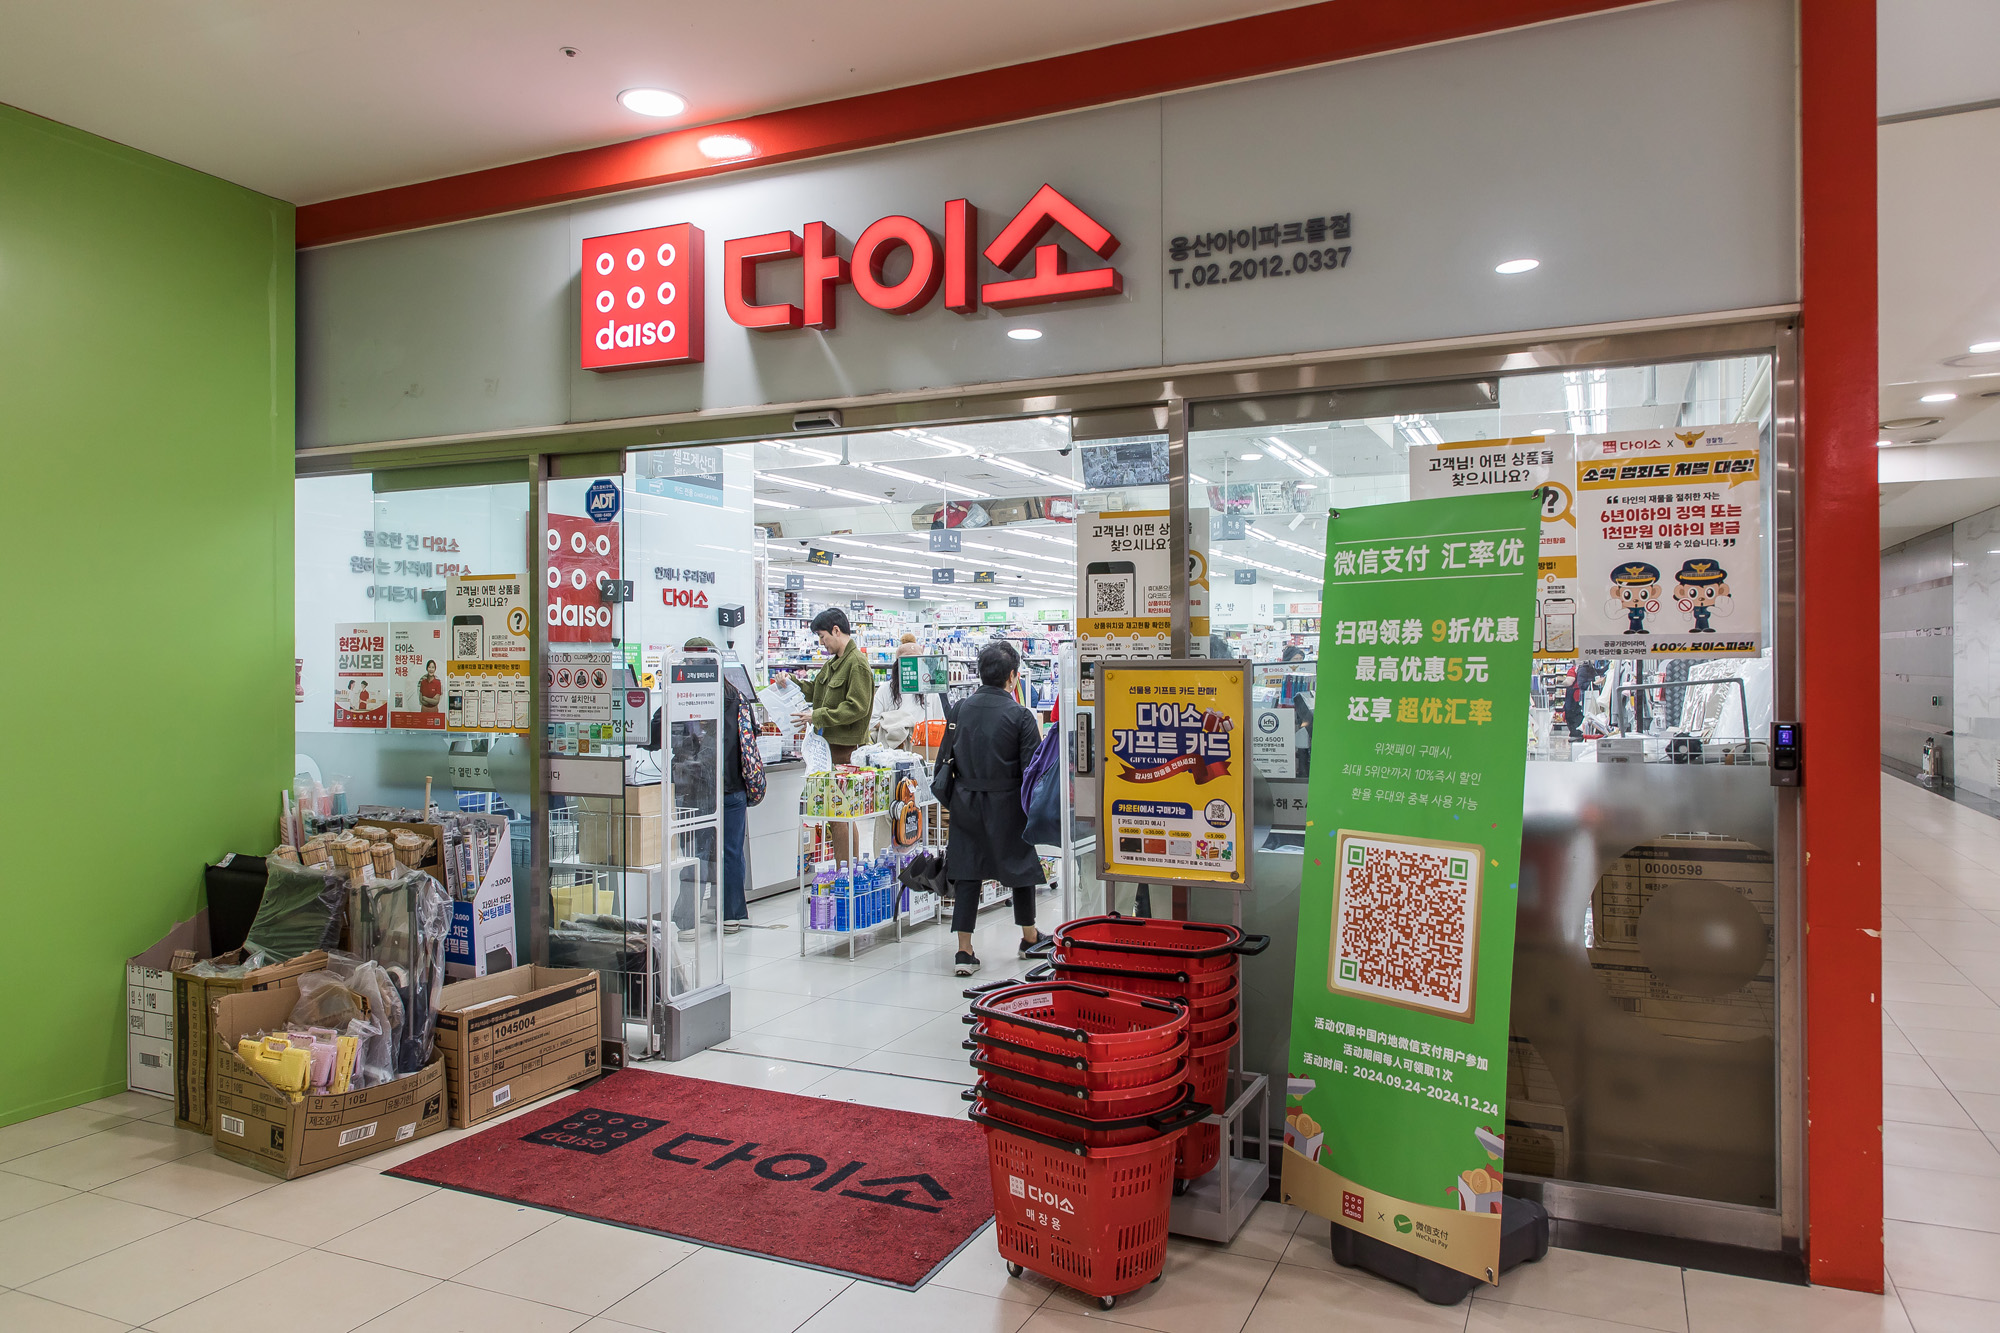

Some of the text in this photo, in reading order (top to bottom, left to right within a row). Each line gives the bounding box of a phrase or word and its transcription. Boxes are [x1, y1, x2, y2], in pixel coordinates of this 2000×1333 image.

[1169, 213, 1353, 261] 용산아이파크몰점
[724, 184, 1123, 333] 다이소
[1169, 247, 1352, 291] T.02.2012.0337
[595, 319, 676, 350] daiso
[1620, 440, 1661, 451] 다이소
[1429, 450, 1554, 473] 고객님! 어떤 상품을
[1582, 458, 1755, 483] 소액 범죄도 처벌 대상!
[1452, 469, 1530, 487] 찾으시나요?
[591, 493, 615, 510] ADT
[1649, 494, 1673, 503] 재물을
[1676, 492, 1701, 502] 절취한
[1703, 491, 1720, 500] 자는
[1600, 503, 1742, 523] 6년이하의 징역 또는
[1092, 524, 1129, 538] 고객님!
[1133, 523, 1156, 536] 어떤
[1602, 521, 1740, 540] 1천만원 이하의 벌금
[364, 530, 461, 552] 필요한 건 다있소
[1618, 537, 1721, 550] 으로 처벌 받을 수 있습니다.
[350, 556, 391, 574] 원하는
[1334, 538, 1525, 576] 微信支付 汇率优
[655, 567, 680, 580] 언제나
[456, 585, 520, 597] 고객님! 어떤 상품을
[607, 584, 629, 596] 2 2
[663, 588, 709, 609] 다이소
[468, 597, 508, 608] 찾으시나요?
[548, 598, 611, 627] daiso
[723, 612, 742, 622] 3 3
[1094, 621, 1150, 629] 상품위치와 재고현황
[1335, 616, 1519, 645] 扫码领券 9折优惠
[339, 636, 384, 652] 현장사원
[395, 644, 415, 653] 다이소
[1623, 647, 1647, 655] 요구하면
[1651, 640, 1754, 652] 100% 보이스피싱!
[339, 654, 384, 670] 상시모집
[395, 654, 423, 665] 현장 직원
[395, 666, 409, 677] 채용
[1355, 656, 1489, 683] 最高优惠5元
[550, 695, 596, 704] CCTV 설치안내
[1129, 686, 1217, 696] 선물용 기프트 카드 판매!
[1137, 703, 1203, 729] 다이소
[1347, 696, 1493, 725] 还享 超优汇率
[1113, 730, 1179, 755] 기프트
[1185, 731, 1230, 757] 카드
[1375, 742, 1452, 760] 위챗페이 구매시,
[1130, 756, 1147, 764] GIFT
[1341, 763, 1482, 786] 최대 5위안까지 10%즉시 할인
[1351, 787, 1478, 811] 환율 우대와 중복 사용 가능
[1118, 804, 1186, 815] 카운터에서 구매가능
[1644, 863, 1703, 876] 0000598
[482, 894, 511, 909] 자외선 차단
[482, 902, 512, 921] 썬팅필름
[453, 925, 469, 938] 차단
[146, 992, 157, 1009] 10입
[495, 1015, 536, 1039] 1045004
[1314, 1016, 1489, 1071] 活动仅限中国内地微信支付用户参加
[1343, 1043, 1454, 1083] 活动期间每人可领取1次
[349, 1093, 368, 1106] 10입
[1352, 1065, 1499, 1117] 2024.09.24-2024.12.24
[309, 1093, 412, 1126] 제조일자 유통기한
[423, 1115, 440, 1127] CHINA
[541, 1131, 607, 1150] daiso
[652, 1131, 954, 1214] 다이소
[1028, 1184, 1075, 1215] 다이소
[1344, 1208, 1362, 1219] daiso
[1415, 1220, 1449, 1241] 微信支付
[1415, 1231, 1449, 1249] WeChat Pay
